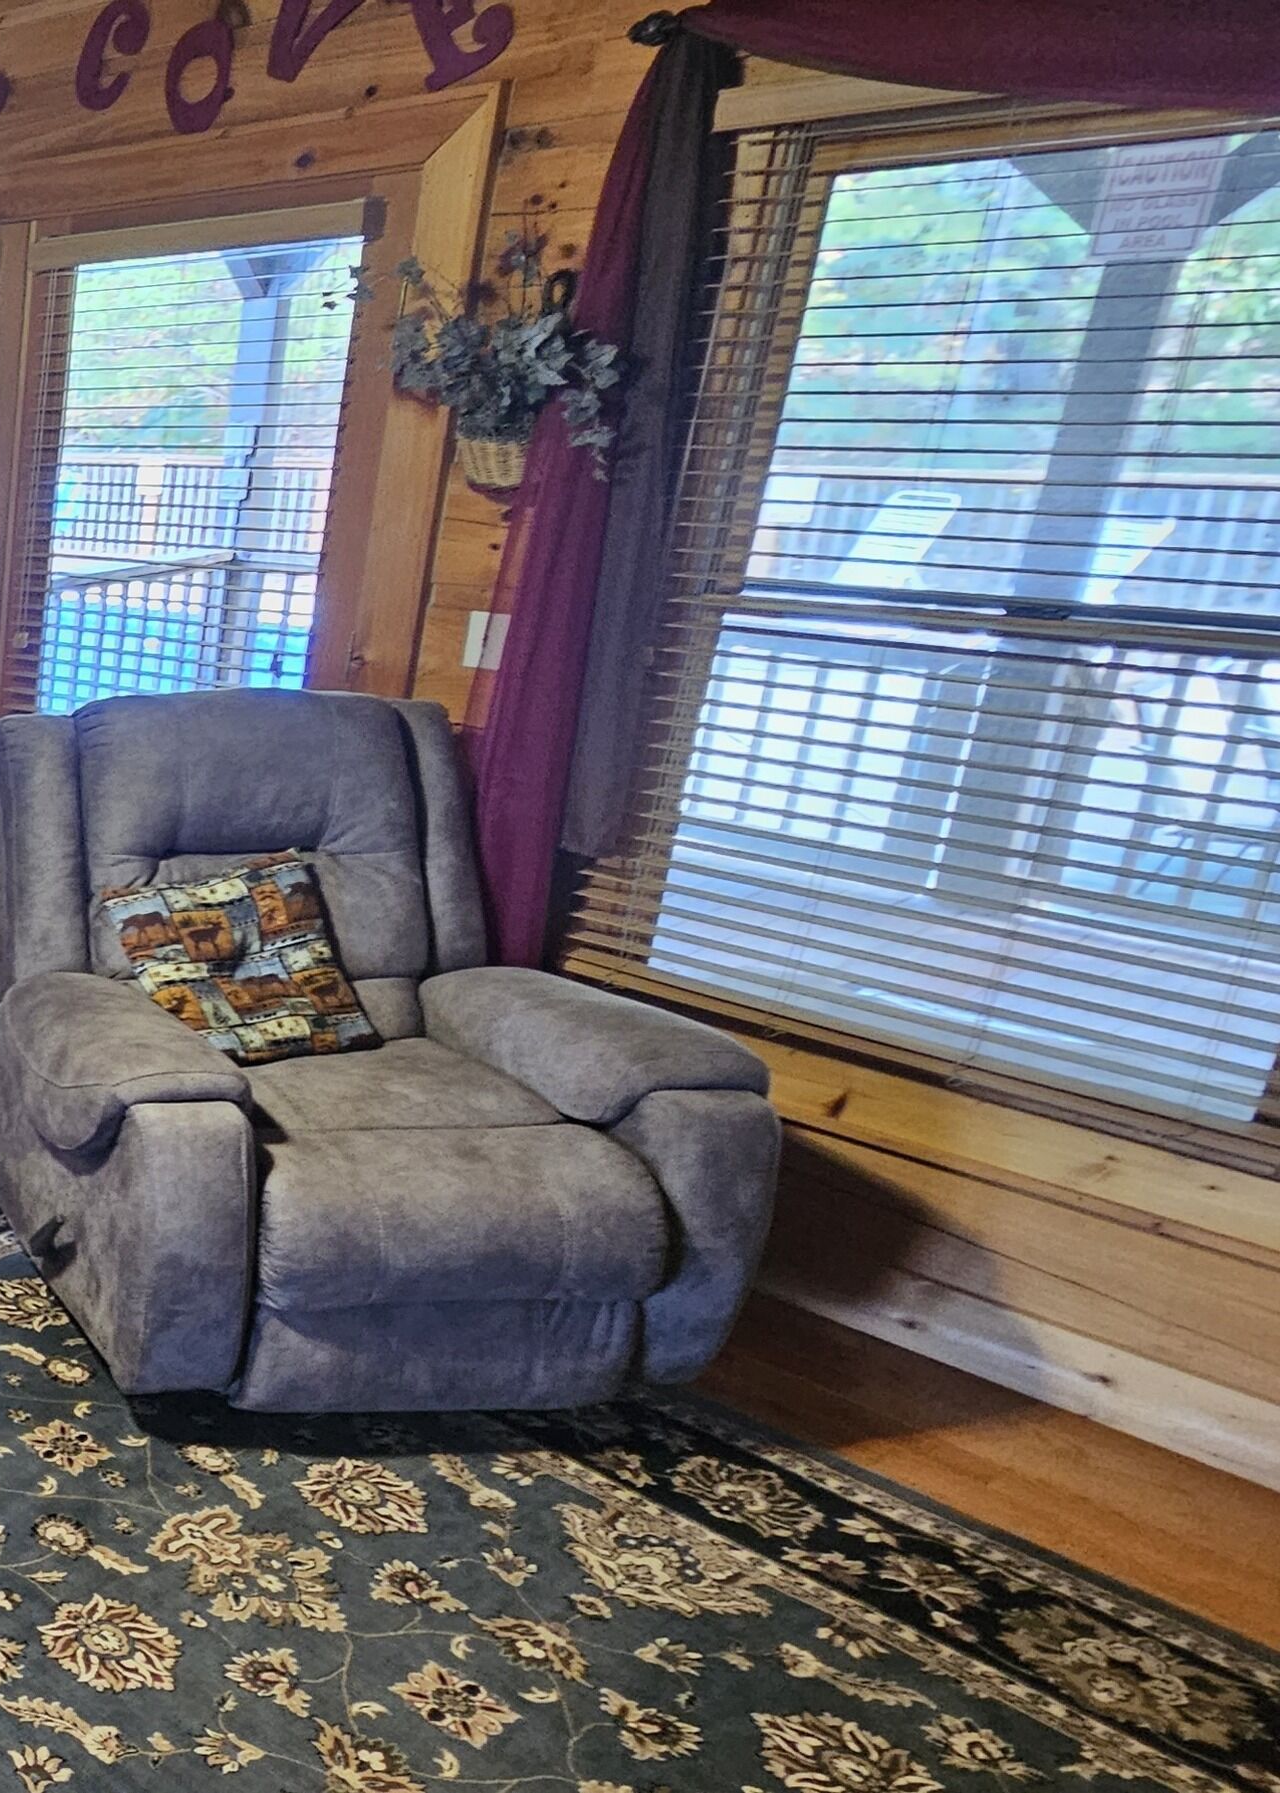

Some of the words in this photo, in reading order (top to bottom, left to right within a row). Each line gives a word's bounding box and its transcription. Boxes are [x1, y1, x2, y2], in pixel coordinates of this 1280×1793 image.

[75, 0, 515, 134] COVE
[1118, 149, 1215, 186] CAUTION
[1136, 214, 1184, 229] POOL
[1119, 234, 1167, 249] AREA
